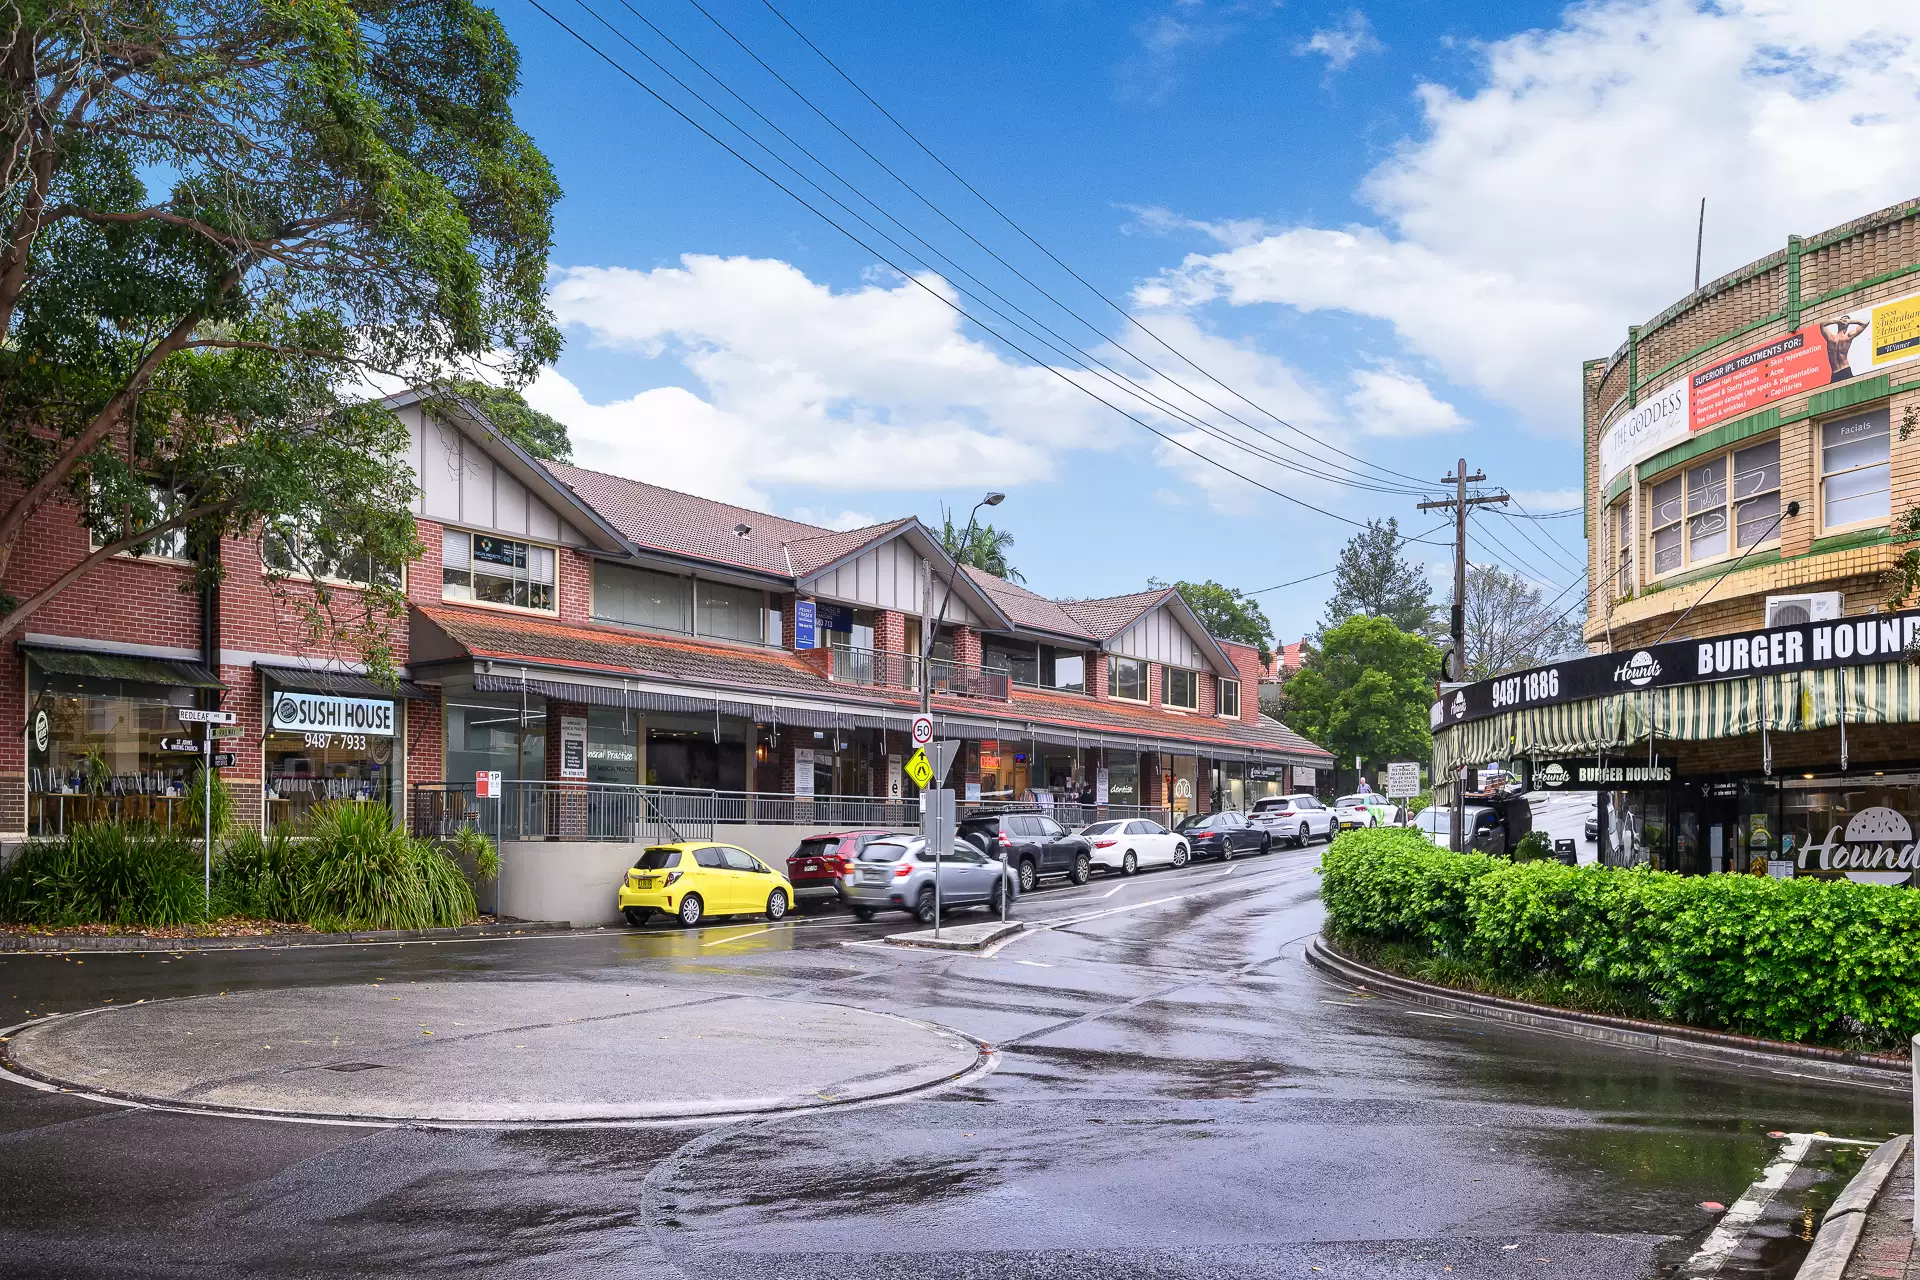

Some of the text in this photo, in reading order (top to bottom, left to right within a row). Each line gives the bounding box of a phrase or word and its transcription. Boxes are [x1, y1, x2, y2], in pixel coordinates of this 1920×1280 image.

[1770, 345, 1822, 367] Skin rejuvenation
[1885, 341, 1911, 353] Winner
[1695, 338, 1802, 386] SUPERIOR IPL TREATMENTS FOR:
[1696, 367, 1758, 396] Permanent Hair reduction
[1770, 368, 1785, 377] Acne
[1696, 390, 1721, 406] Pigmented
[1726, 382, 1742, 394] Spotty
[1743, 376, 1760, 386] hands
[1714, 400, 1724, 408] sun
[1724, 393, 1744, 406] damage
[1756, 381, 1772, 393] spots
[1773, 378, 1779, 386] &
[1779, 366, 1820, 385] pigmentation
[1770, 382, 1803, 397] Capillaries
[1614, 423, 1627, 451] THE
[1629, 389, 1682, 437] GODDESS
[1840, 421, 1871, 436] Facials
[1698, 631, 1804, 675] BURGER
[1613, 659, 1663, 682] Hounds
[1492, 668, 1559, 709] 9487 1886
[180, 710, 210, 721] REDLEAF
[298, 699, 391, 730] SUSHI HOUSE
[916, 725, 930, 737] 50
[304, 732, 332, 749] 9487
[340, 734, 366, 751] 7933
[588, 749, 633, 761] neral Practice
[490, 773, 500, 781] 1P
[1578, 767, 1623, 782] BURGER
[1625, 767, 1672, 782] HOUNDS
[1110, 784, 1133, 794] dentist
